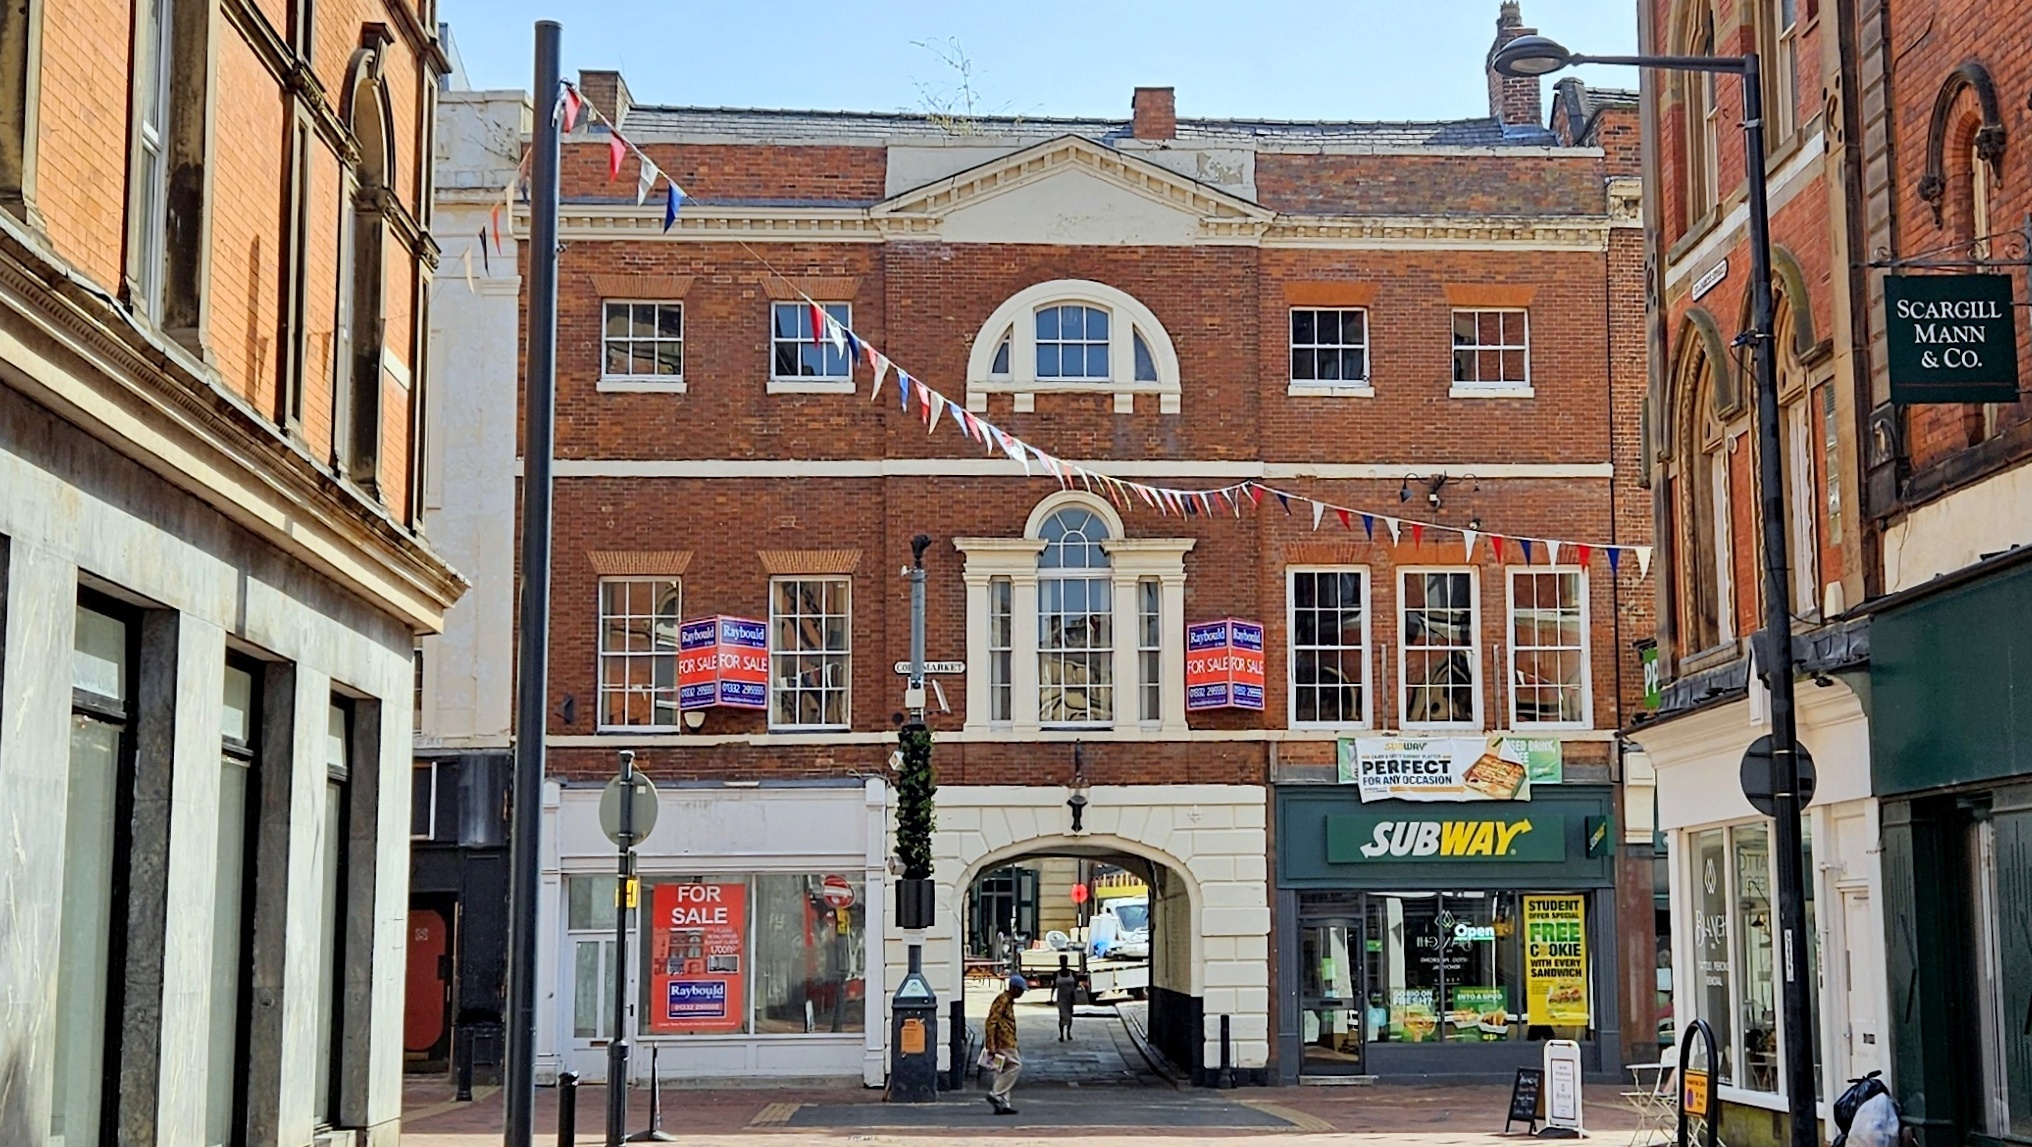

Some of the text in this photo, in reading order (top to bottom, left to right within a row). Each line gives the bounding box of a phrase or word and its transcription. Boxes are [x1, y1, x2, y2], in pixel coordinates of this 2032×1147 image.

[1896, 299, 2003, 319] SCARGILL
[1913, 323, 1985, 344] MANN
[1921, 347, 1983, 369] & CO.
[682, 626, 715, 644] Raybould
[723, 624, 765, 640] Raybould
[1190, 626, 1226, 645] Raybould
[1232, 627, 1261, 644] Raybould
[678, 655, 718, 675] FOR SALE
[719, 653, 768, 673] FOR SALE
[1187, 656, 1229, 675] FOR SALE
[1230, 656, 1264, 675] FOR SALE
[1384, 742, 1428, 751] SUBWAY
[1361, 760, 1452, 775] PERFECT
[1363, 775, 1453, 786] FOR ANY OCCASION
[1360, 818, 1533, 859] SUBWAY
[678, 885, 722, 903] FOR
[1528, 900, 1580, 911] STUDENT
[671, 907, 728, 925] SALE
[1454, 923, 1495, 939] Open
[1529, 922, 1581, 942] FREE
[1530, 959, 1581, 967] WITH EVERY
[1530, 968, 1582, 978] SANDWICH
[670, 984, 724, 999] Raybould
